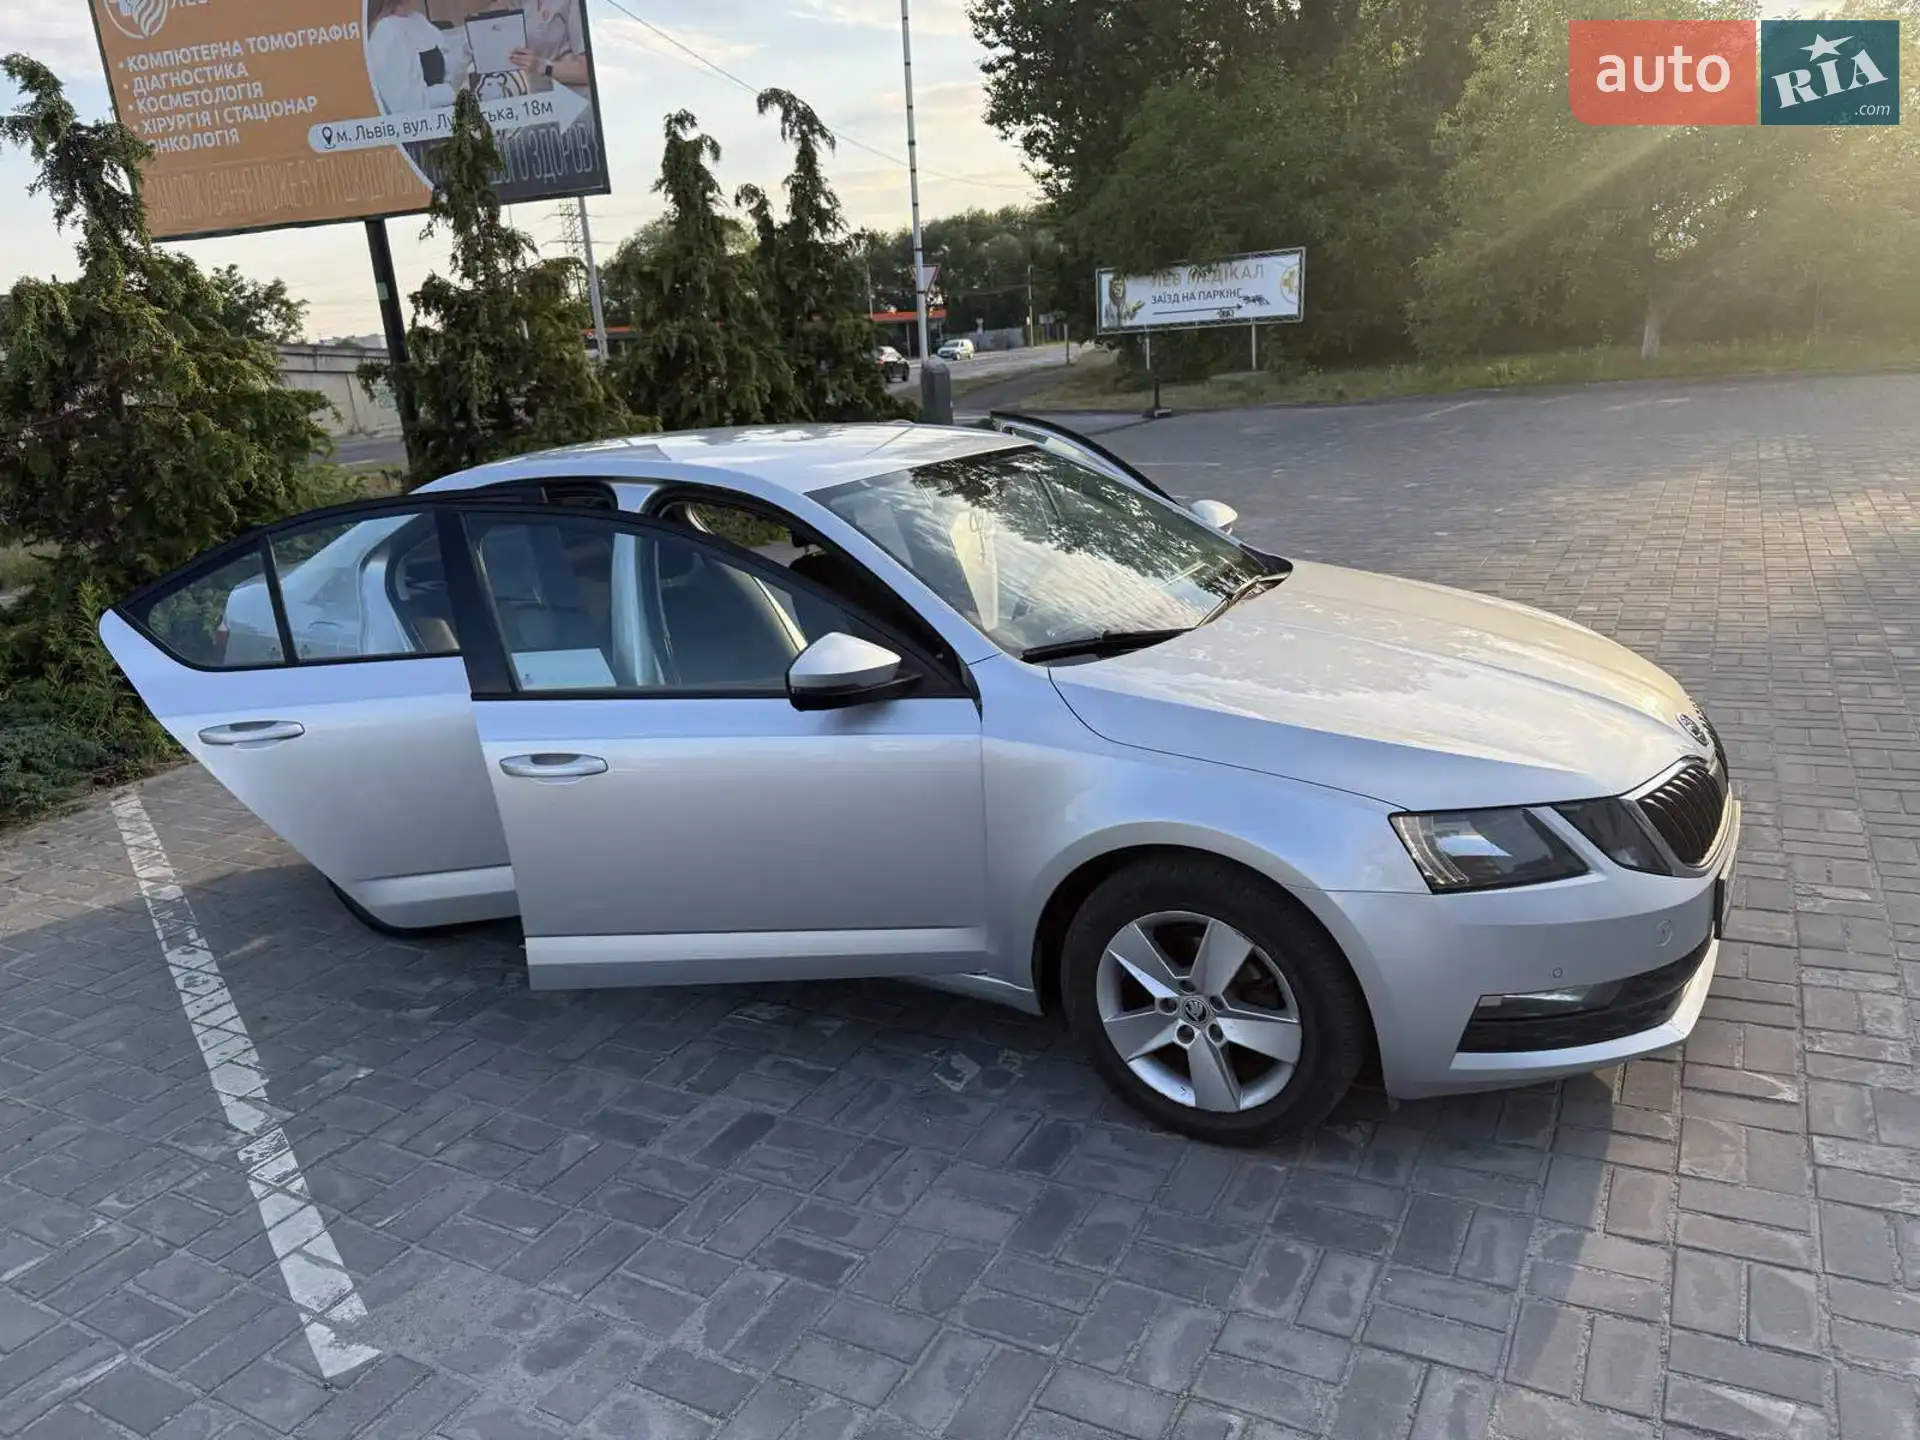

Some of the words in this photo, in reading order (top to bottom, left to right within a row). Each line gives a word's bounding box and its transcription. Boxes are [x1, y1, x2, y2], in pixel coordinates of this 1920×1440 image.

[126, 39, 245, 73] КОМПЮТЕРНА
[245, 21, 360, 54] ТОМОГРАФІЯ
[133, 62, 250, 97] ДІАГНОСТИКА
[136, 81, 264, 115] КОСМЕТОЛОГІЯ
[142, 110, 212, 136] ХІРУРГІЯ
[223, 95, 318, 123] СТАЦІОНАР
[336, 130, 353, 143] м.
[355, 121, 401, 141] Львів,
[402, 118, 433, 137] вул.
[522, 99, 553, 117] 18м
[1182, 291, 1197, 302] НА
[1198, 288, 1243, 300] ПАРКІНГ
